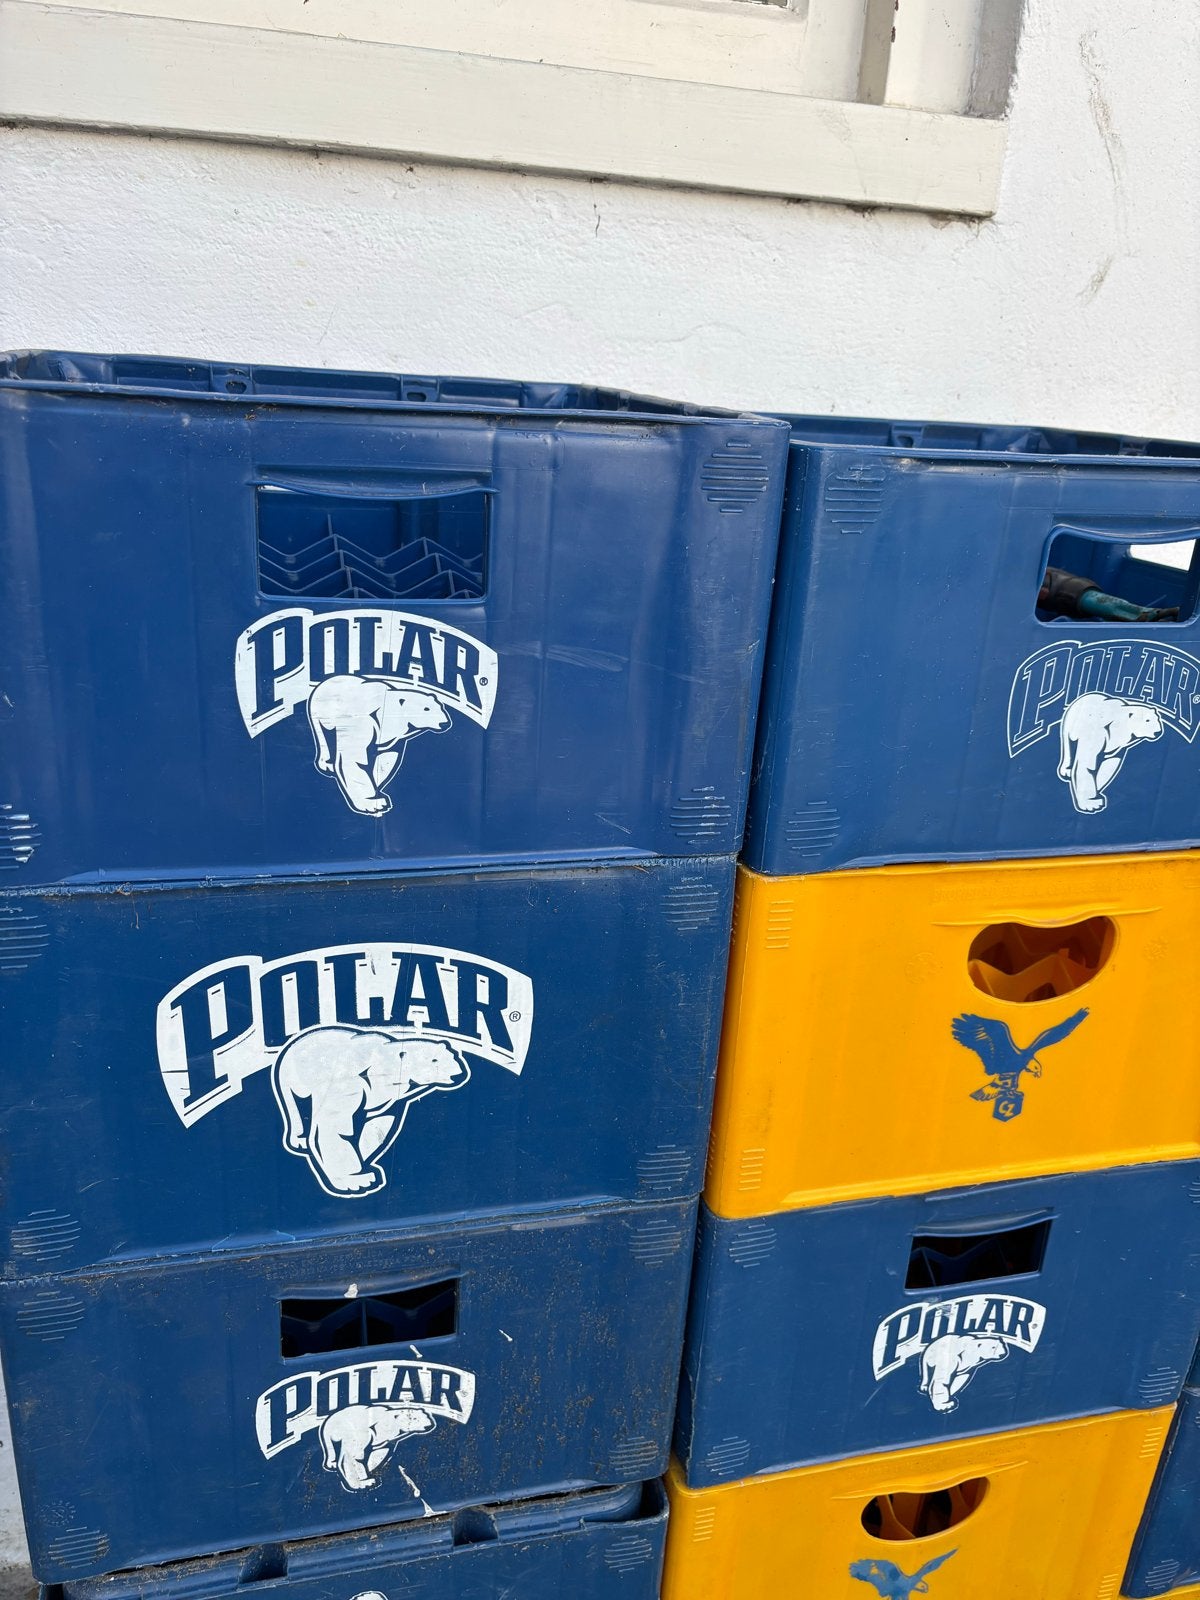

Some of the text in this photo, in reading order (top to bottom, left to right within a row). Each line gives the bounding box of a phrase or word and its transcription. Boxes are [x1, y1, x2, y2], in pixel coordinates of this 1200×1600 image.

[248, 616, 483, 720] POLAR
[1014, 646, 1200, 743] POLAR
[171, 952, 514, 1108] POLAR
[878, 1298, 1035, 1372] POLAR
[264, 1365, 464, 1450] POLAR
